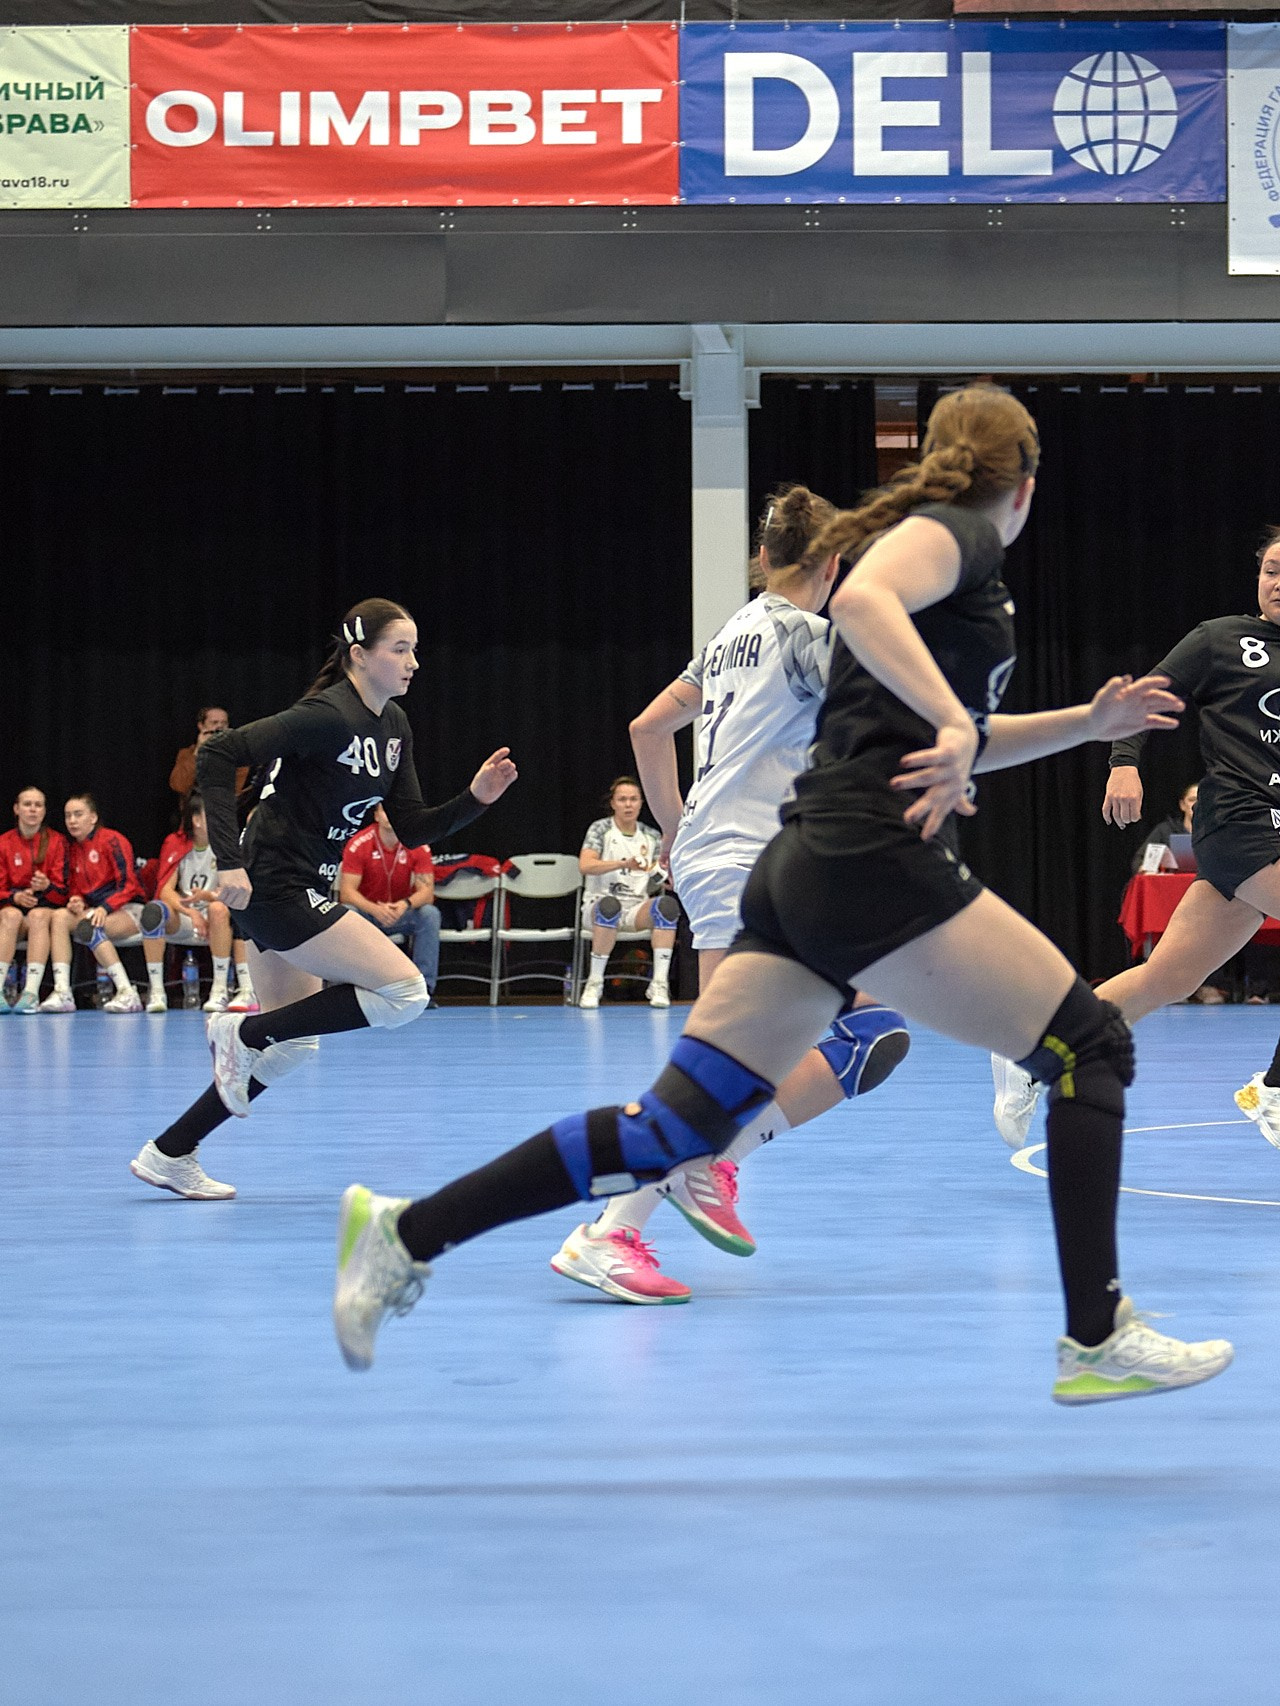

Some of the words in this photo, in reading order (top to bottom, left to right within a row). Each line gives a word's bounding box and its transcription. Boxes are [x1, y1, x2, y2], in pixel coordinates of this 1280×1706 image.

[0, 113, 105, 134] РАВА»
[145, 89, 663, 147] OLIMPBET
[1253, 103, 1280, 202] ФЕДЕРАЦИЯ
[0, 176, 69, 188] ava18.ru
[1239, 636, 1270, 669] 8
[337, 735, 381, 778] 40
